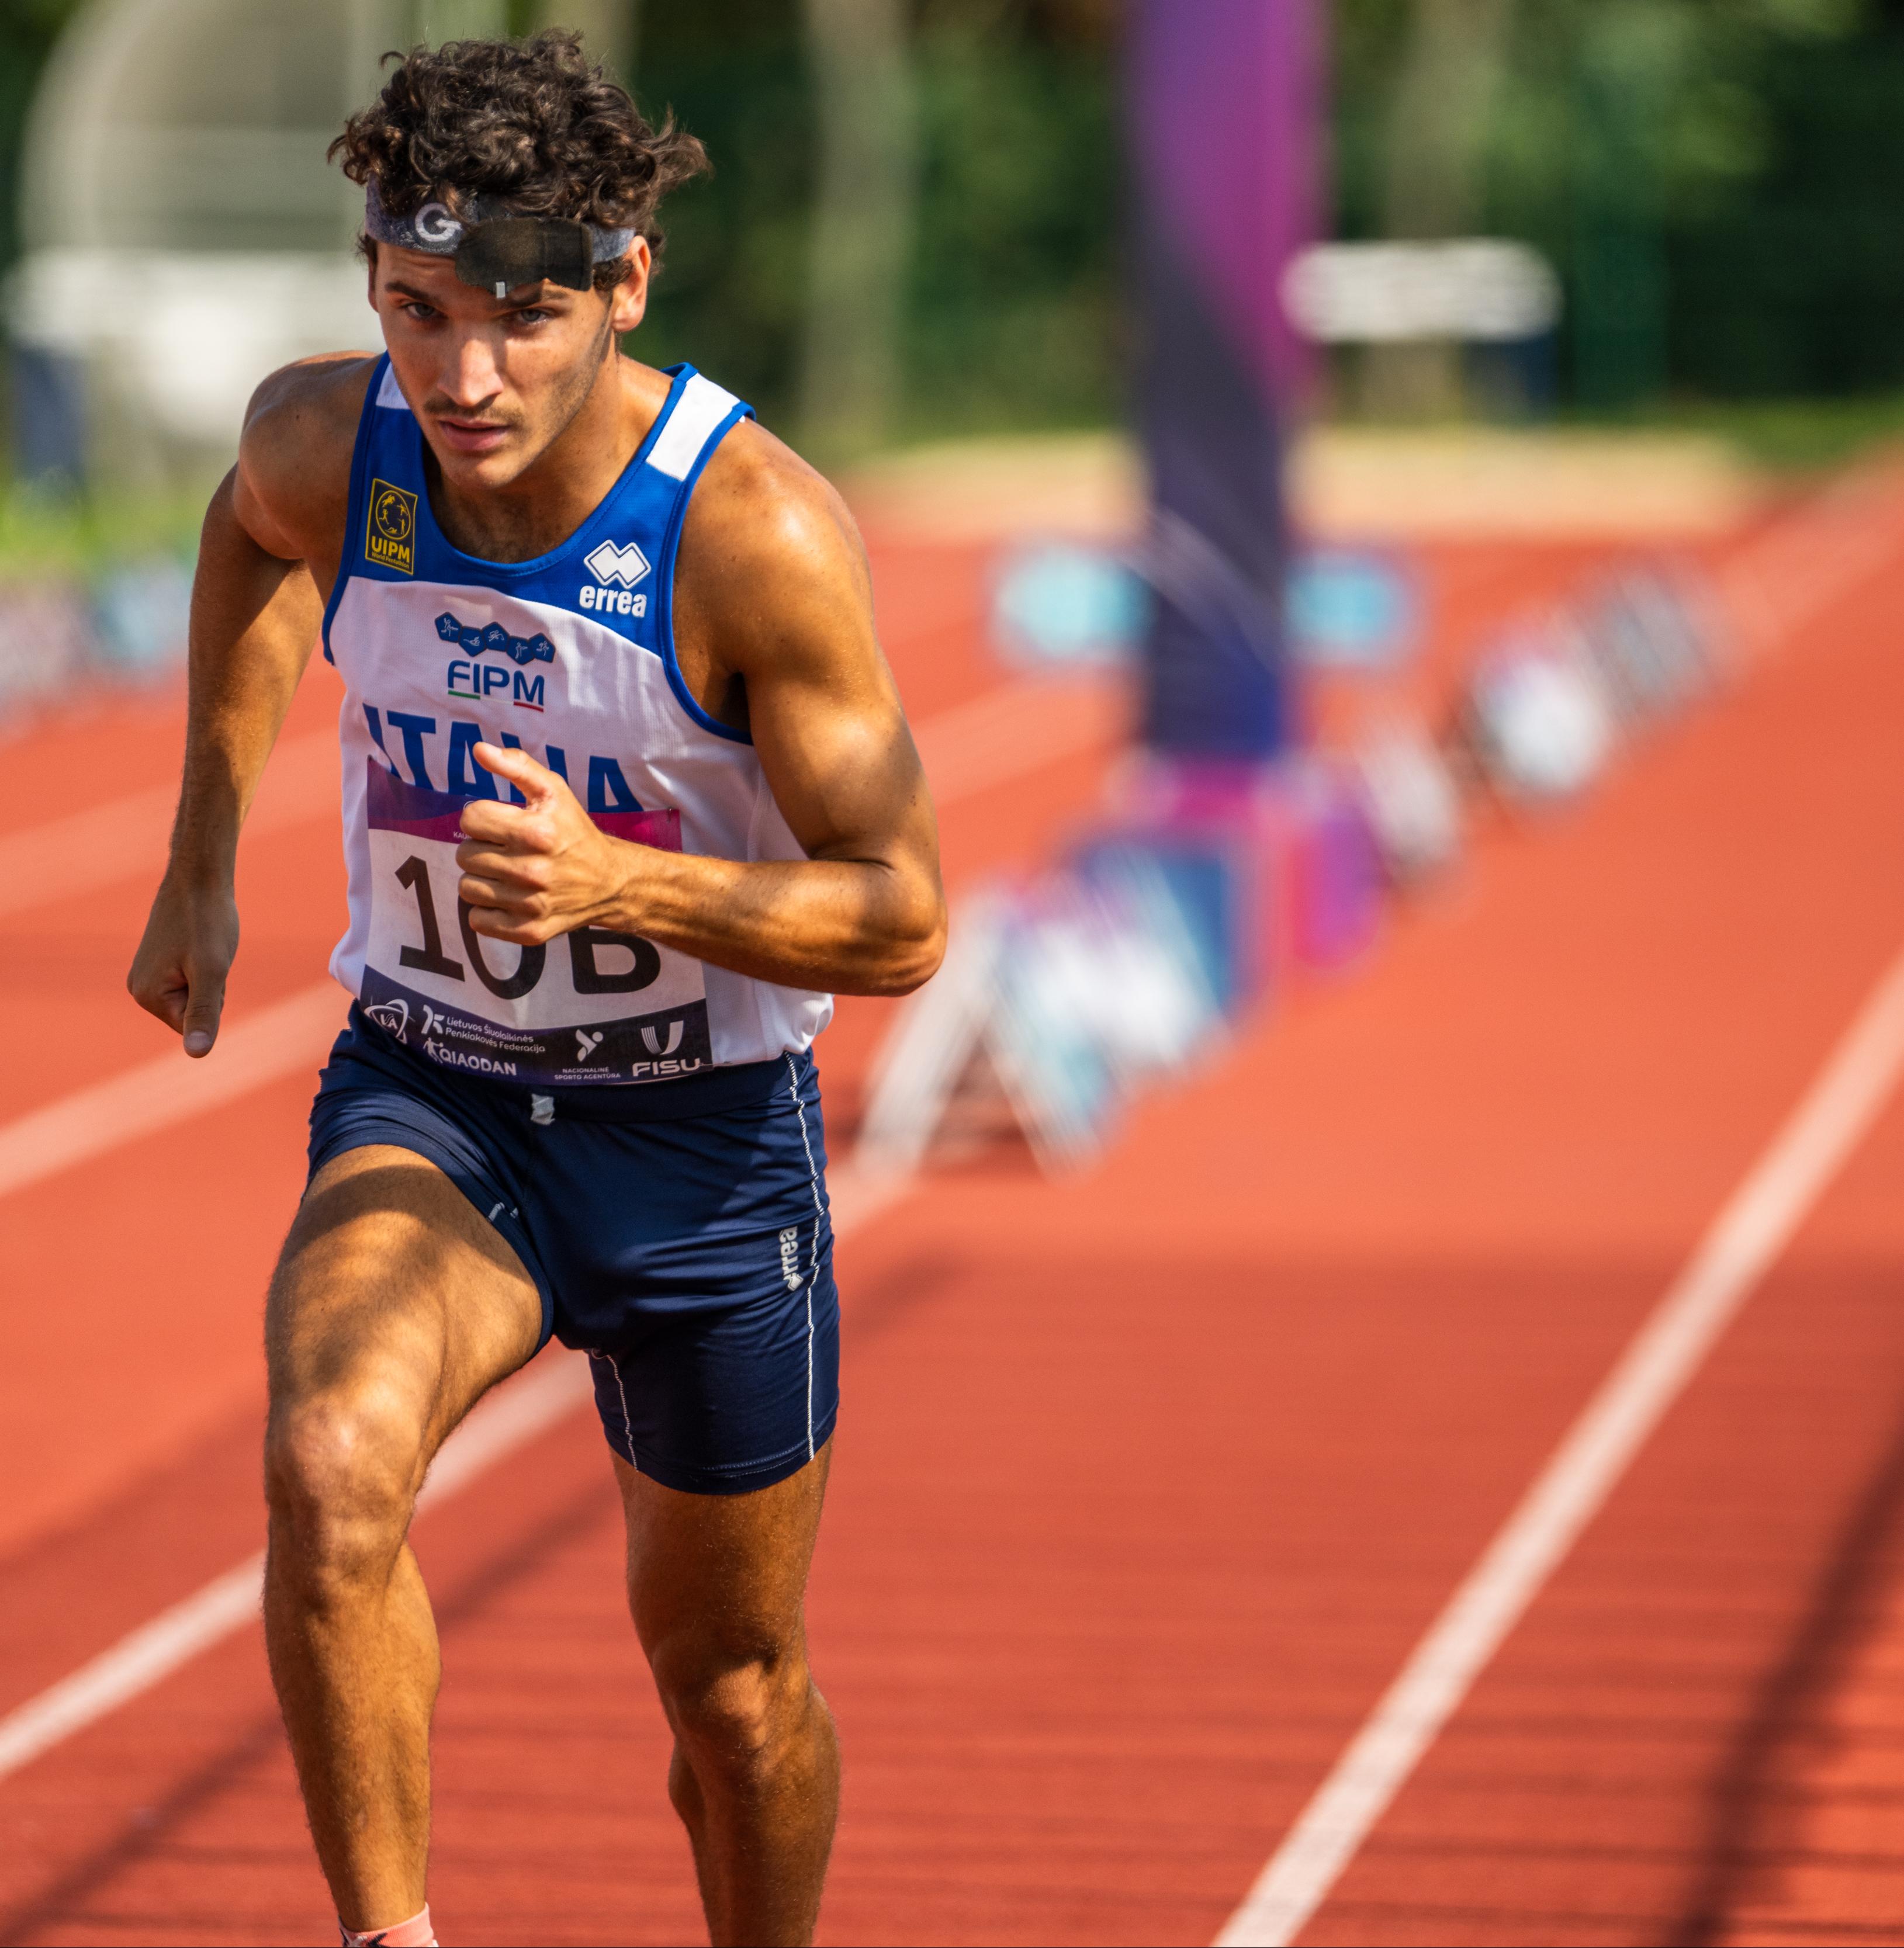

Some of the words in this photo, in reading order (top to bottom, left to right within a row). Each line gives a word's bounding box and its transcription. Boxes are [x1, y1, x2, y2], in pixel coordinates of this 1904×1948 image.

[371, 535, 410, 563] UIPM
[371, 551, 385, 560] World
[386, 556, 410, 569] Pentathlon
[579, 585, 648, 618] errea
[448, 660, 545, 705] FIPM
[445, 1027, 497, 1048] Penkiakovės
[498, 1041, 546, 1054] Federacija
[446, 1016, 482, 1032] Lietuvos
[483, 1024, 534, 1042] Šiuolaikinės
[439, 1048, 517, 1076] QIAODAN
[632, 1058, 701, 1077] FISU
[778, 1226, 799, 1281] rrea
